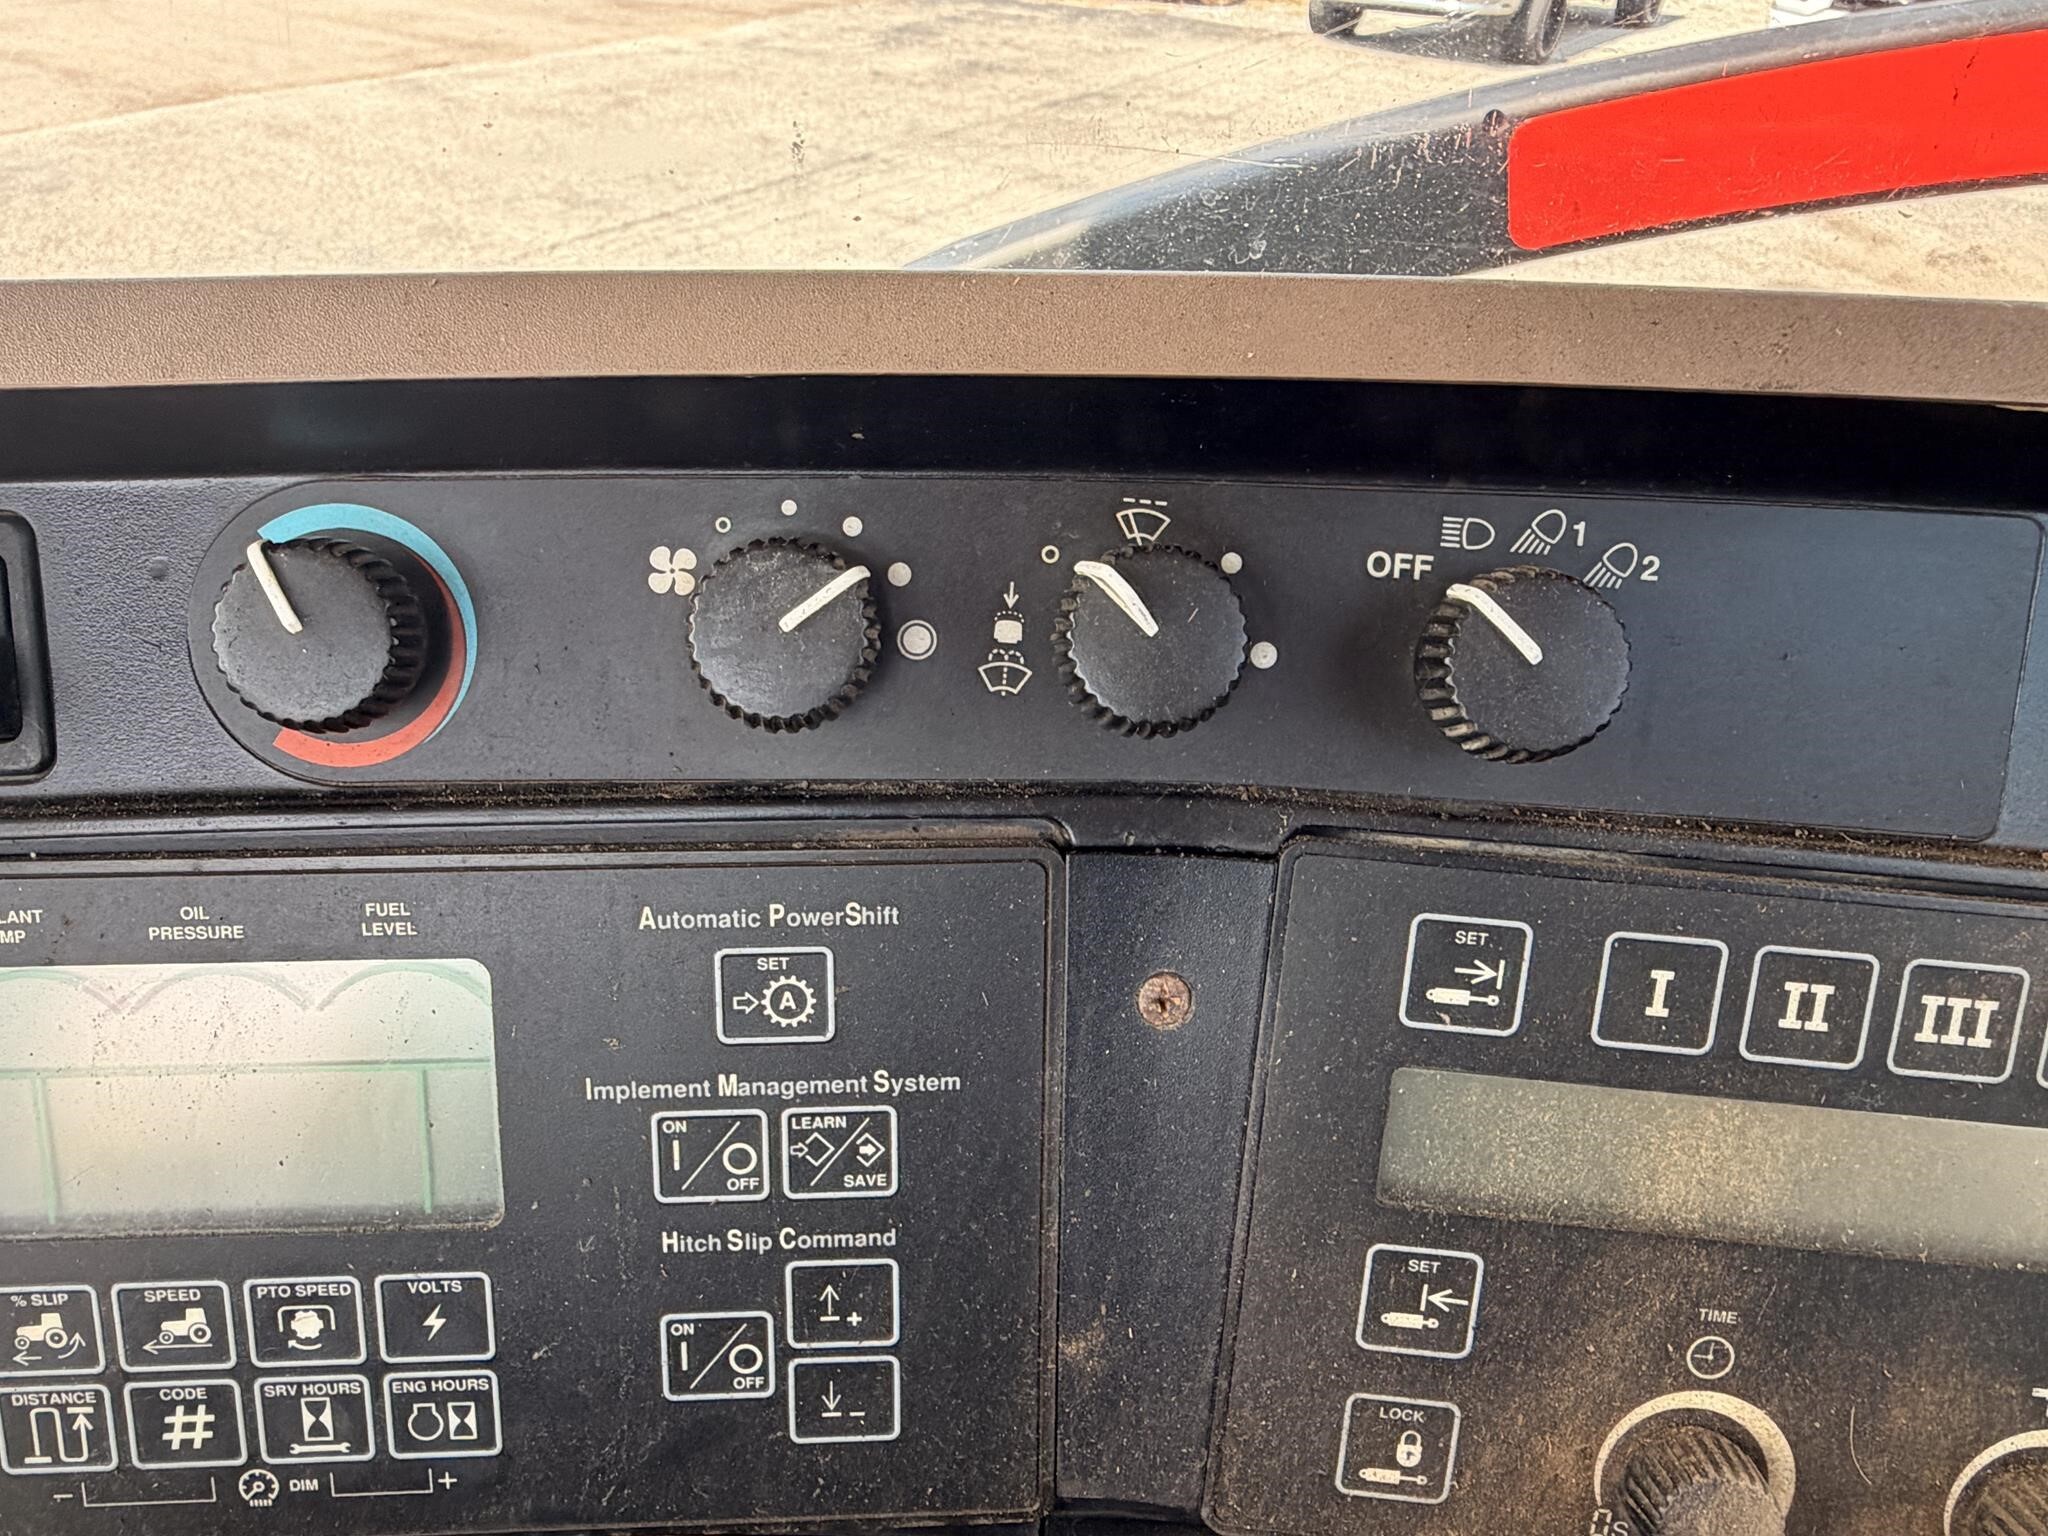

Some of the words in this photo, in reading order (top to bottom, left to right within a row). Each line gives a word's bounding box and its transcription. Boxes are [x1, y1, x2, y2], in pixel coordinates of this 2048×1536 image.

[1573, 521, 1586, 546] 1
[1367, 551, 1434, 580] OFF
[1640, 555, 1660, 581] 2
[180, 906, 209, 921] OIL
[365, 903, 410, 917] FUEL
[639, 906, 760, 931] Automatic
[768, 903, 899, 928] PowerShift
[149, 926, 245, 940] PRESSURE
[362, 922, 418, 936] LEVEL
[1454, 931, 1489, 946] SET
[757, 957, 790, 971] SET
[1646, 969, 1675, 1017] I
[779, 992, 797, 1010] A
[1778, 981, 1835, 1031] II
[1914, 995, 2000, 1048] III
[585, 1076, 710, 1103] Implement
[718, 1074, 867, 1100] Management
[874, 1070, 961, 1096] System
[663, 1121, 687, 1133] ON
[792, 1116, 847, 1129] LEARN
[727, 1177, 759, 1191] OFF
[844, 1174, 887, 1187] SAVE
[662, 1232, 721, 1253] Hitch
[727, 1229, 772, 1254] Slip
[779, 1228, 896, 1249] Command
[1408, 1259, 1441, 1274] SET
[257, 1285, 291, 1299] PTO
[295, 1283, 351, 1298] SPEED
[407, 1280, 462, 1294] VOLTS
[10, 1296, 28, 1307] %
[31, 1292, 68, 1307] SLIP
[144, 1289, 201, 1303] SPEED
[1698, 1309, 1738, 1324] TIME
[671, 1324, 695, 1335] ON
[264, 1383, 300, 1397] SRV
[303, 1382, 361, 1396] HOURS
[392, 1380, 427, 1393] ENG
[431, 1378, 489, 1392] HOURS
[734, 1377, 764, 1390] OFF
[11, 1391, 97, 1406] DISTANCE
[159, 1387, 207, 1401] CODE
[1379, 1406, 1424, 1423] LOCK
[290, 1478, 319, 1493] DIM
